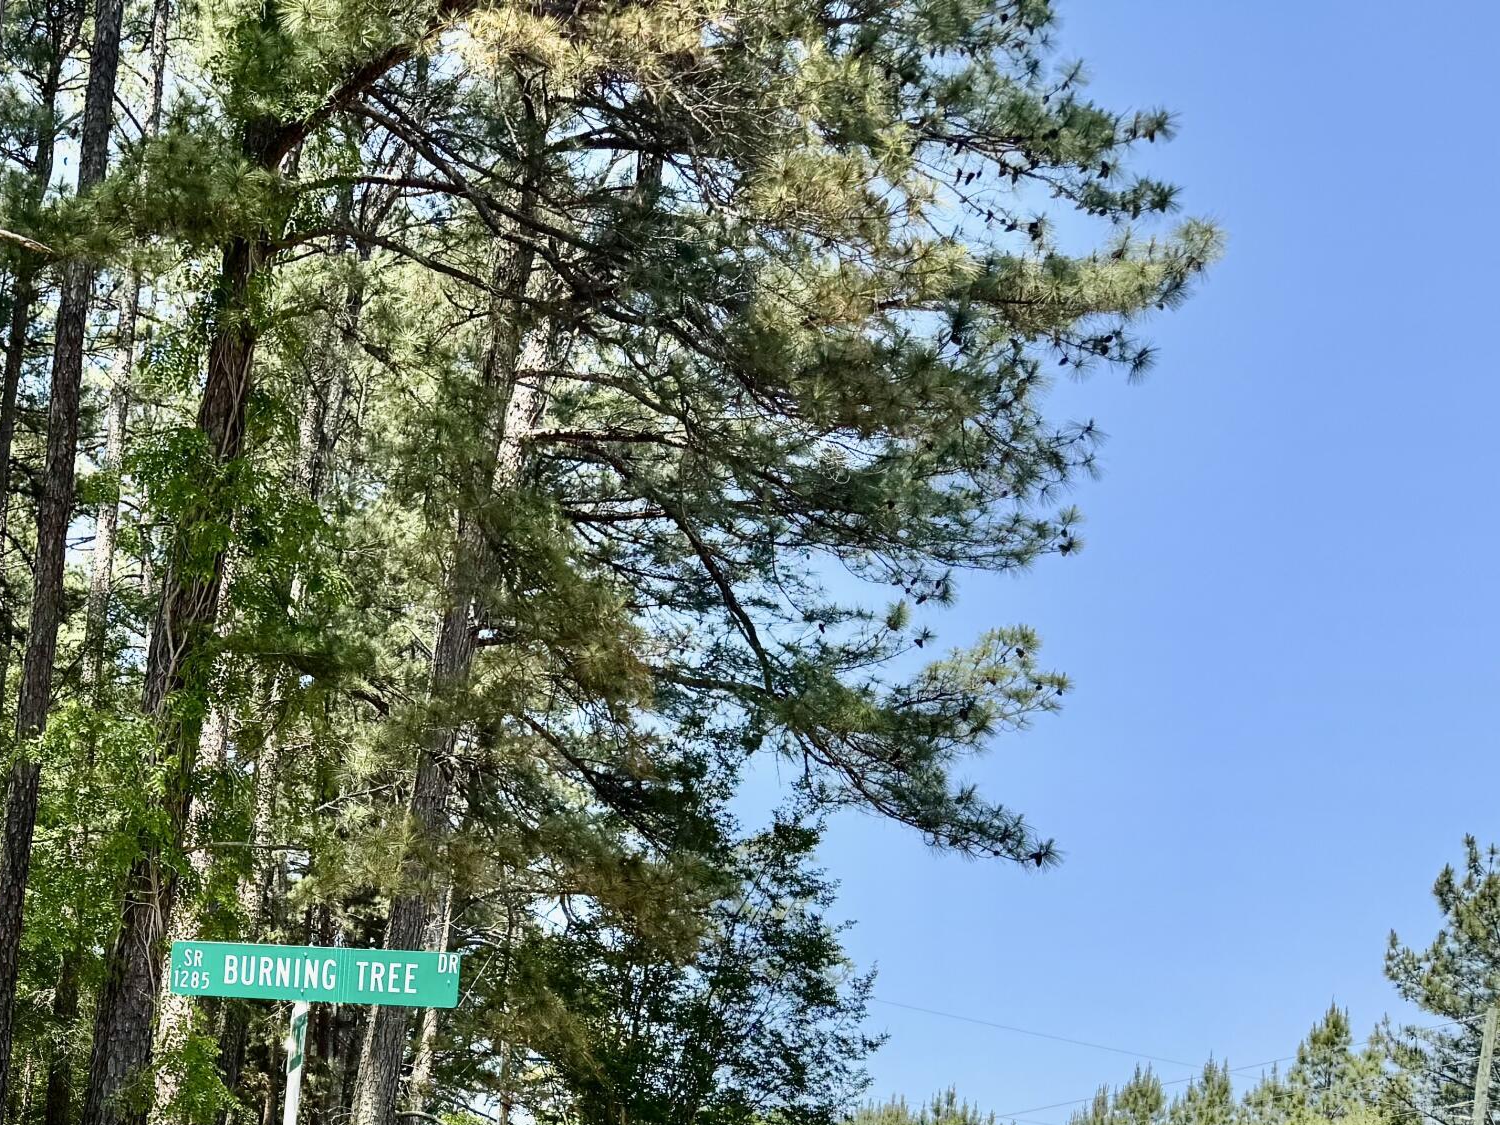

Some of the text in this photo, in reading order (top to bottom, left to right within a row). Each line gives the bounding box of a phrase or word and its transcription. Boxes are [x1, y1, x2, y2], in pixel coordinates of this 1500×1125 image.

[183, 948, 204, 968] SR
[173, 969, 211, 991] 1285
[223, 952, 460, 994] BURNING TREE DR
